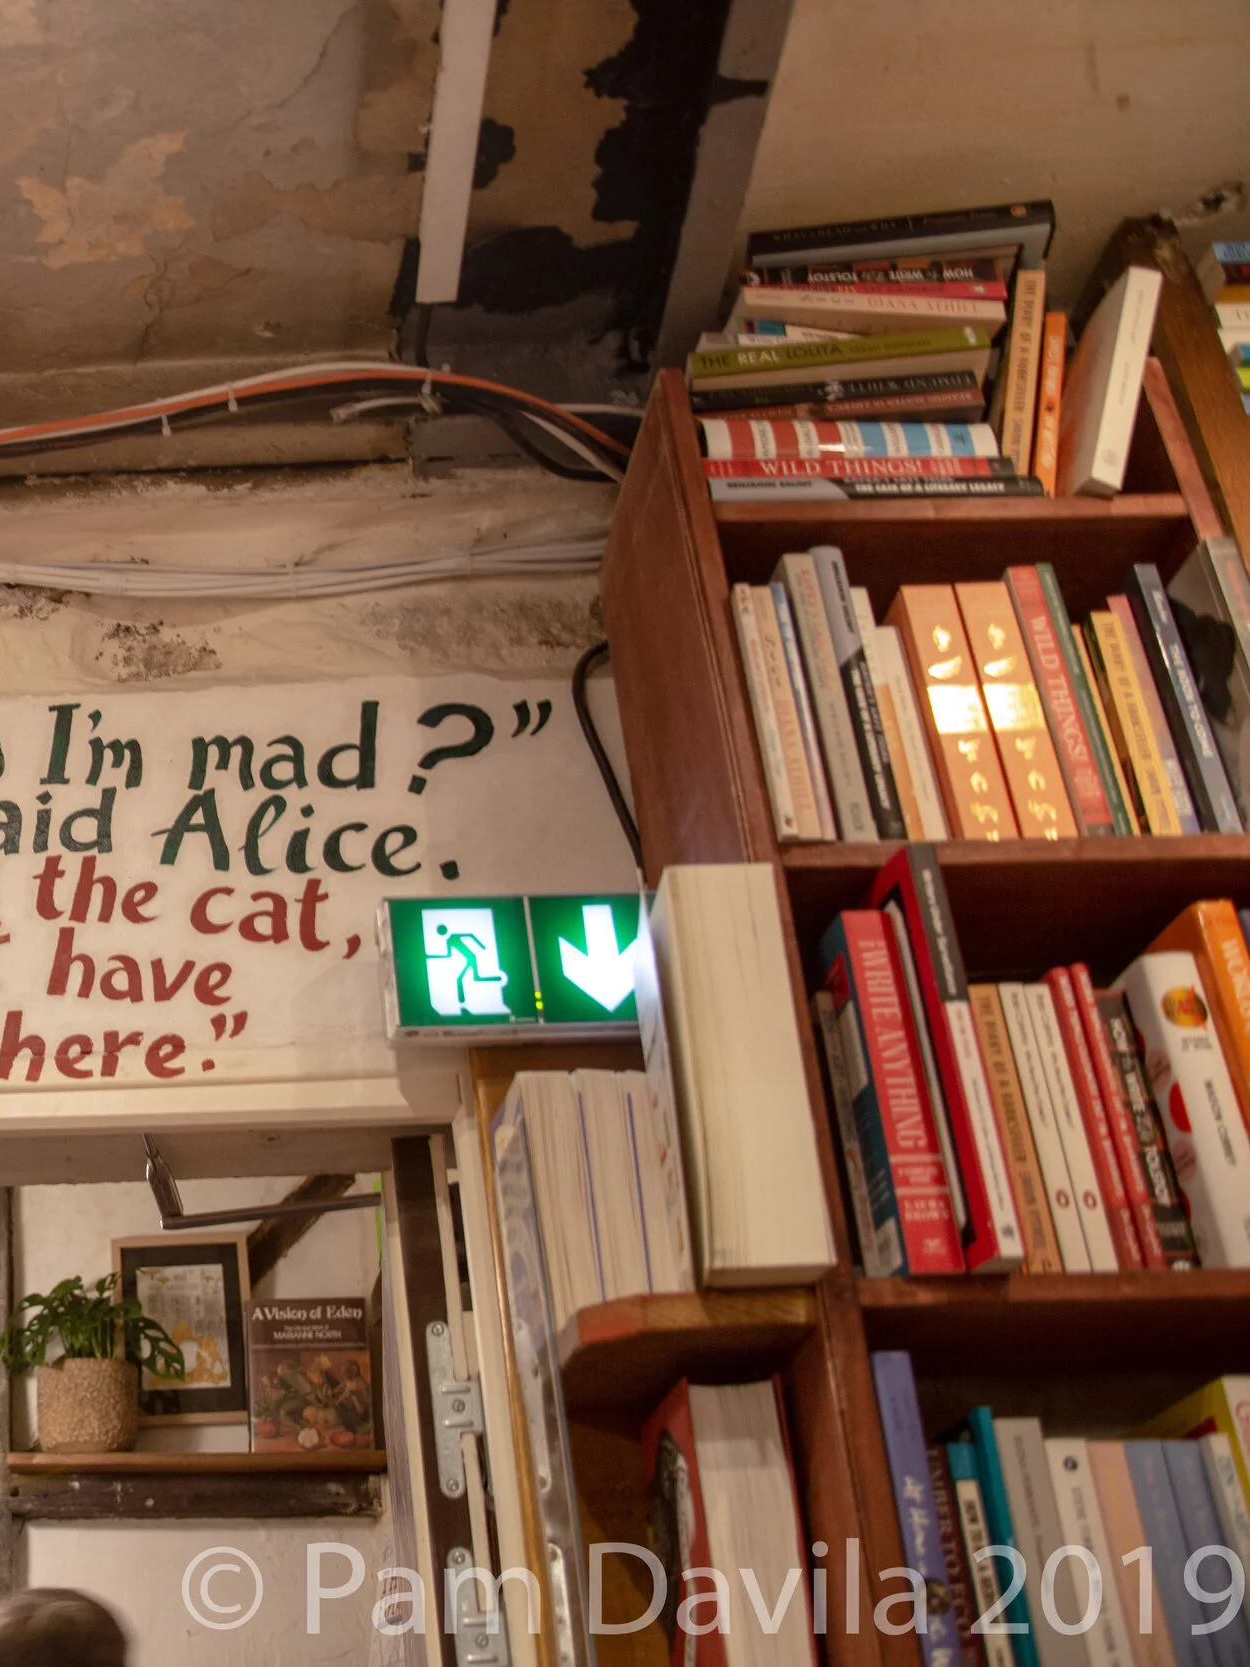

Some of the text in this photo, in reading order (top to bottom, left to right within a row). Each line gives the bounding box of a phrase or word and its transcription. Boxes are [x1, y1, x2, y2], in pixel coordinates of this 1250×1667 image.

[701, 343, 843, 369] THE REAL LOLITA
[759, 459, 923, 476] WILD THINGS!
[1030, 615, 1060, 670] WILD
[1047, 675, 1088, 763] THINGS!
[151, 788, 460, 880] Alice.
[32, 855, 158, 939] the
[190, 878, 361, 959] cat,
[46, 926, 232, 1005] have
[861, 949, 928, 1147] WRITE ANYTHING
[1109, 1017, 1128, 1052] HOW
[1146, 1145, 1171, 1207] TOLSTOY
[252, 1303, 363, 1321] A Vision of Eden
